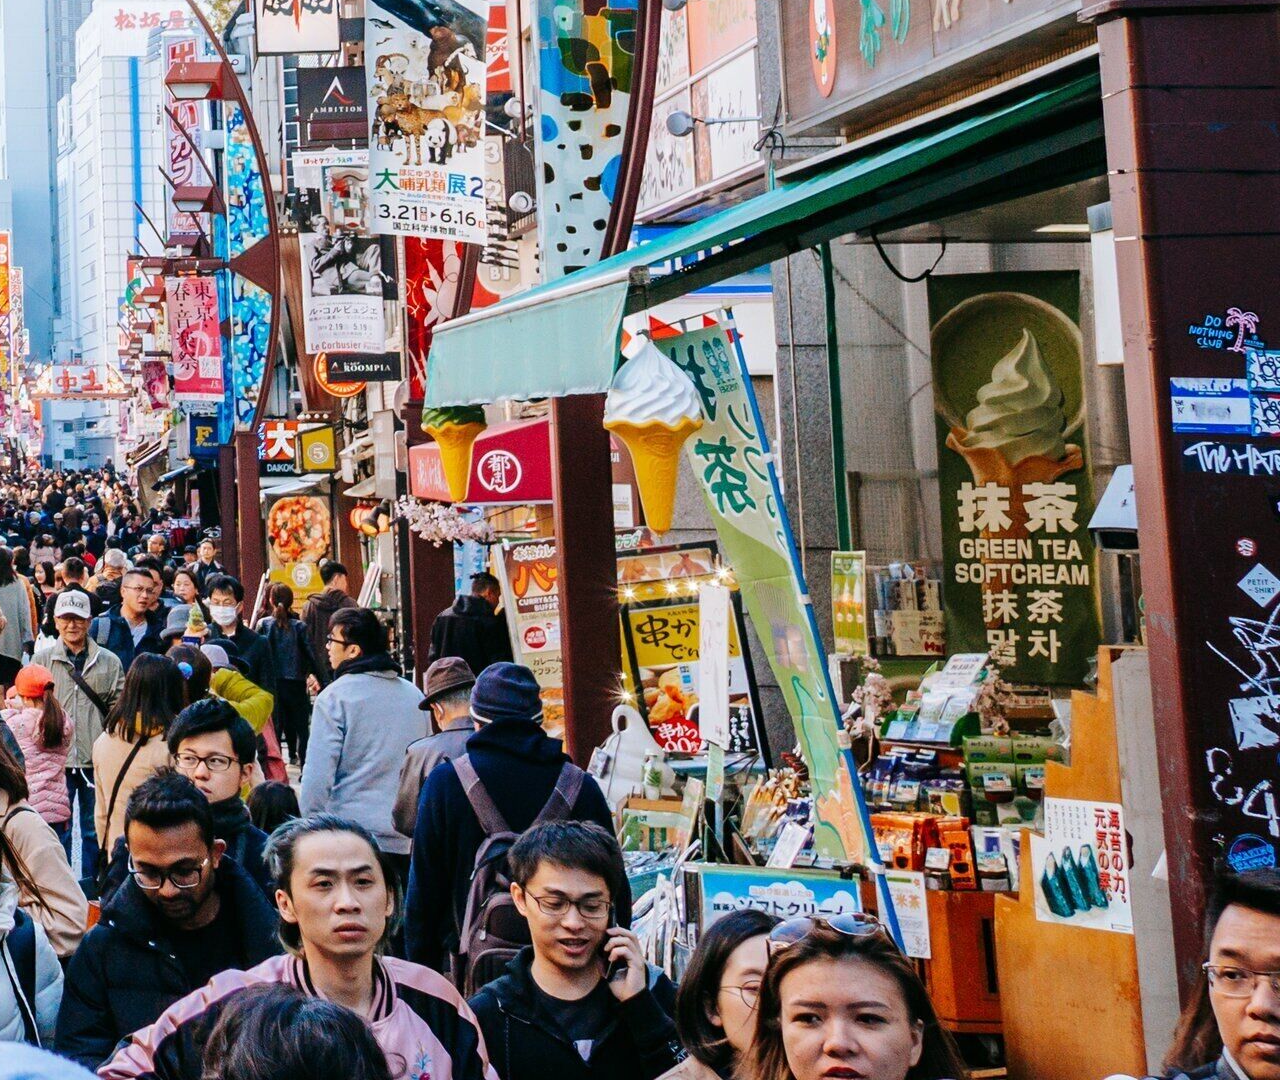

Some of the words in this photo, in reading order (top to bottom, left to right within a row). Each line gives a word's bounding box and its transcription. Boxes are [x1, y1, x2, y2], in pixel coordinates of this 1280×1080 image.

[379, 204, 418, 220] 3.21
[440, 208, 477, 226] 6.16
[1205, 315, 1222, 327] DO
[1189, 325, 1234, 340] NOTHING
[311, 342, 320, 351] Le
[322, 340, 361, 351] Corbusier
[1196, 337, 1223, 348] CLUB
[957, 481, 1079, 534] 抹茶
[959, 538, 1033, 560] GREEN
[1038, 540, 1083, 561] TEA
[955, 563, 1090, 586] SOFTCREAM
[1247, 578, 1269, 586] PETIT
[983, 589, 1064, 624] 抹茶
